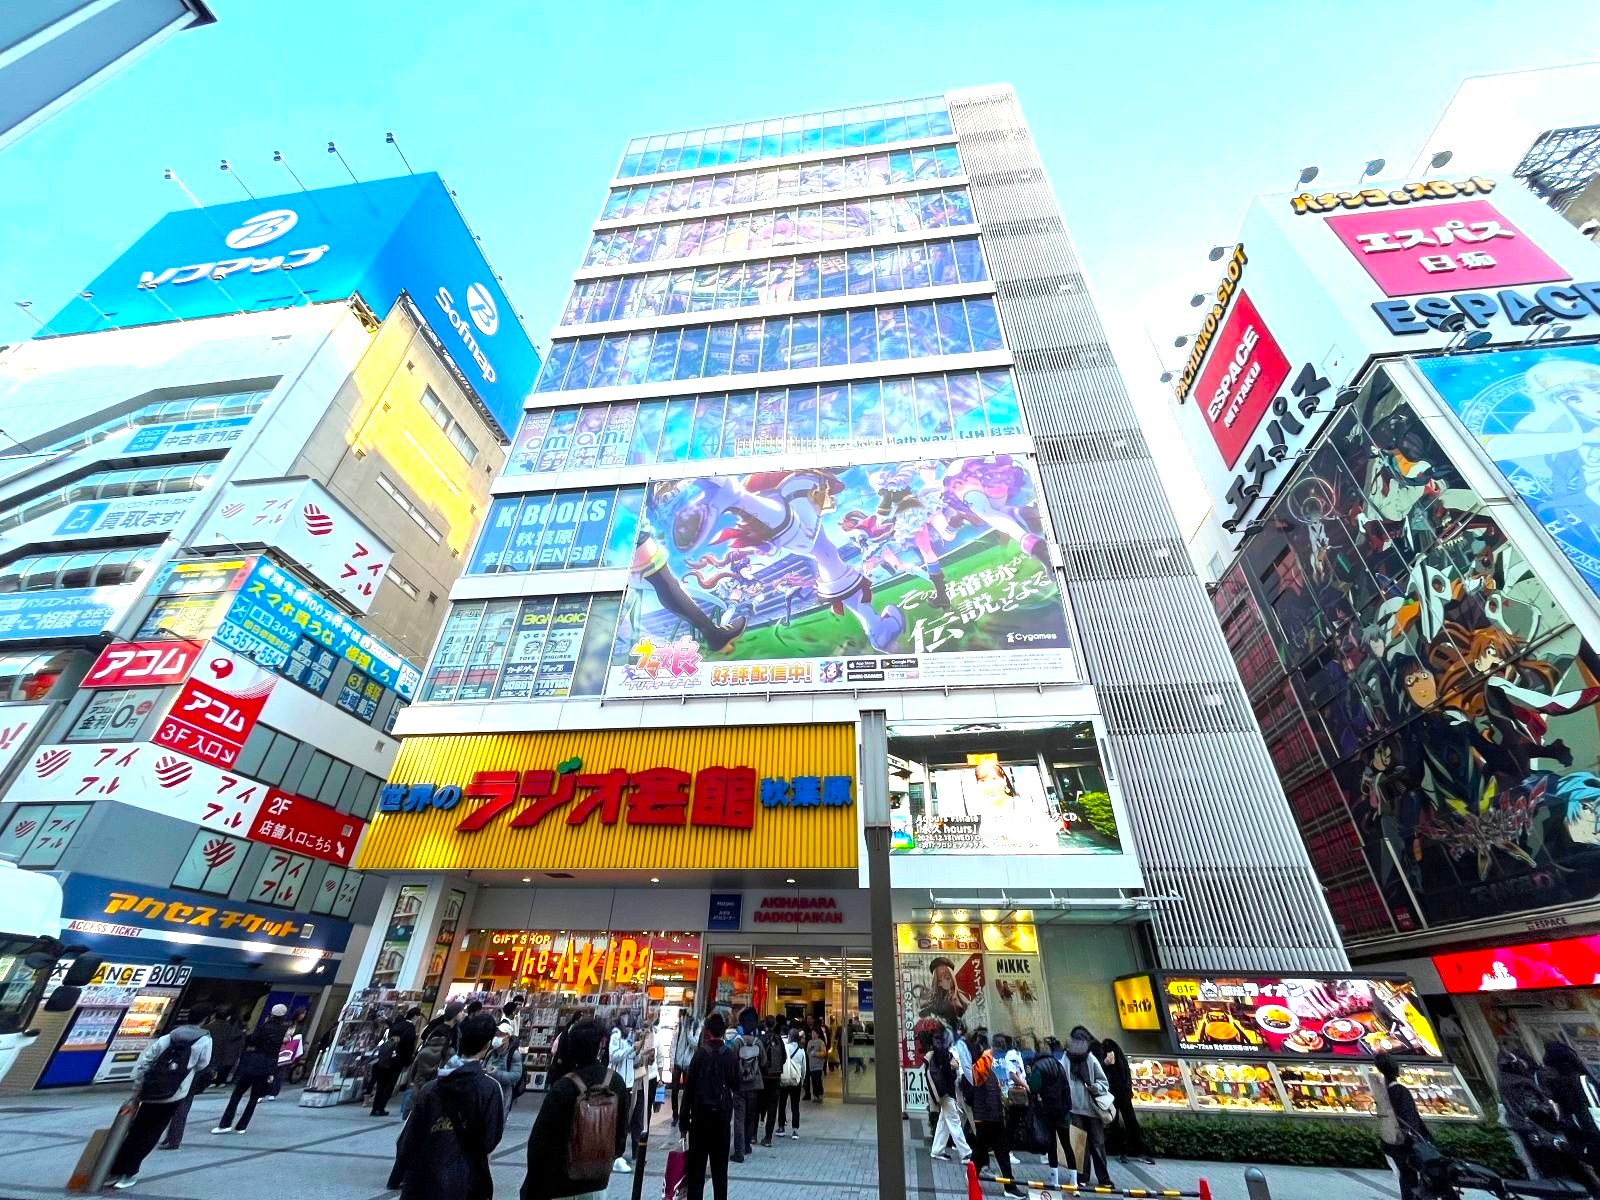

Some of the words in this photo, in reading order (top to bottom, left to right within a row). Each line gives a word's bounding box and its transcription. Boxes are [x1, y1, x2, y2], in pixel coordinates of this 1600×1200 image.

[1356, 219, 1516, 255] エスパス
[137, 244, 330, 290] ソフマップ
[435, 286, 496, 383] Sofmap
[1207, 324, 1260, 423] ESPACE
[164, 429, 244, 447] 中古専門店
[1014, 632, 1057, 642] Cygames
[92, 648, 188, 679] アコム
[711, 663, 813, 687] 好評配信中!
[183, 690, 246, 733] アコム
[160, 723, 192, 744] 3F
[189, 735, 222, 758] 入口
[94, 747, 140, 767] アイ
[75, 776, 120, 796] フル
[216, 775, 257, 804] アイ
[378, 782, 462, 814] 世界の
[455, 756, 757, 832] ラジオ会館
[760, 775, 853, 808] 秋葉原
[202, 802, 243, 828] フル
[268, 797, 292, 816] 2F
[258, 820, 332, 853] 店舗入口こちら
[104, 892, 300, 938] アクセスチケット
[760, 897, 838, 909] AKIHABARA
[68, 920, 108, 933] ACCESS
[110, 924, 142, 938] TICKET
[752, 911, 844, 924] RADIOKAIKAN
[1535, 917, 1568, 930] ESPACE
[492, 934, 518, 945] GIFT
[520, 934, 551, 945] SHOP
[511, 946, 549, 976] The
[149, 965, 192, 985] 80円
[1176, 983, 1195, 994] B1F
